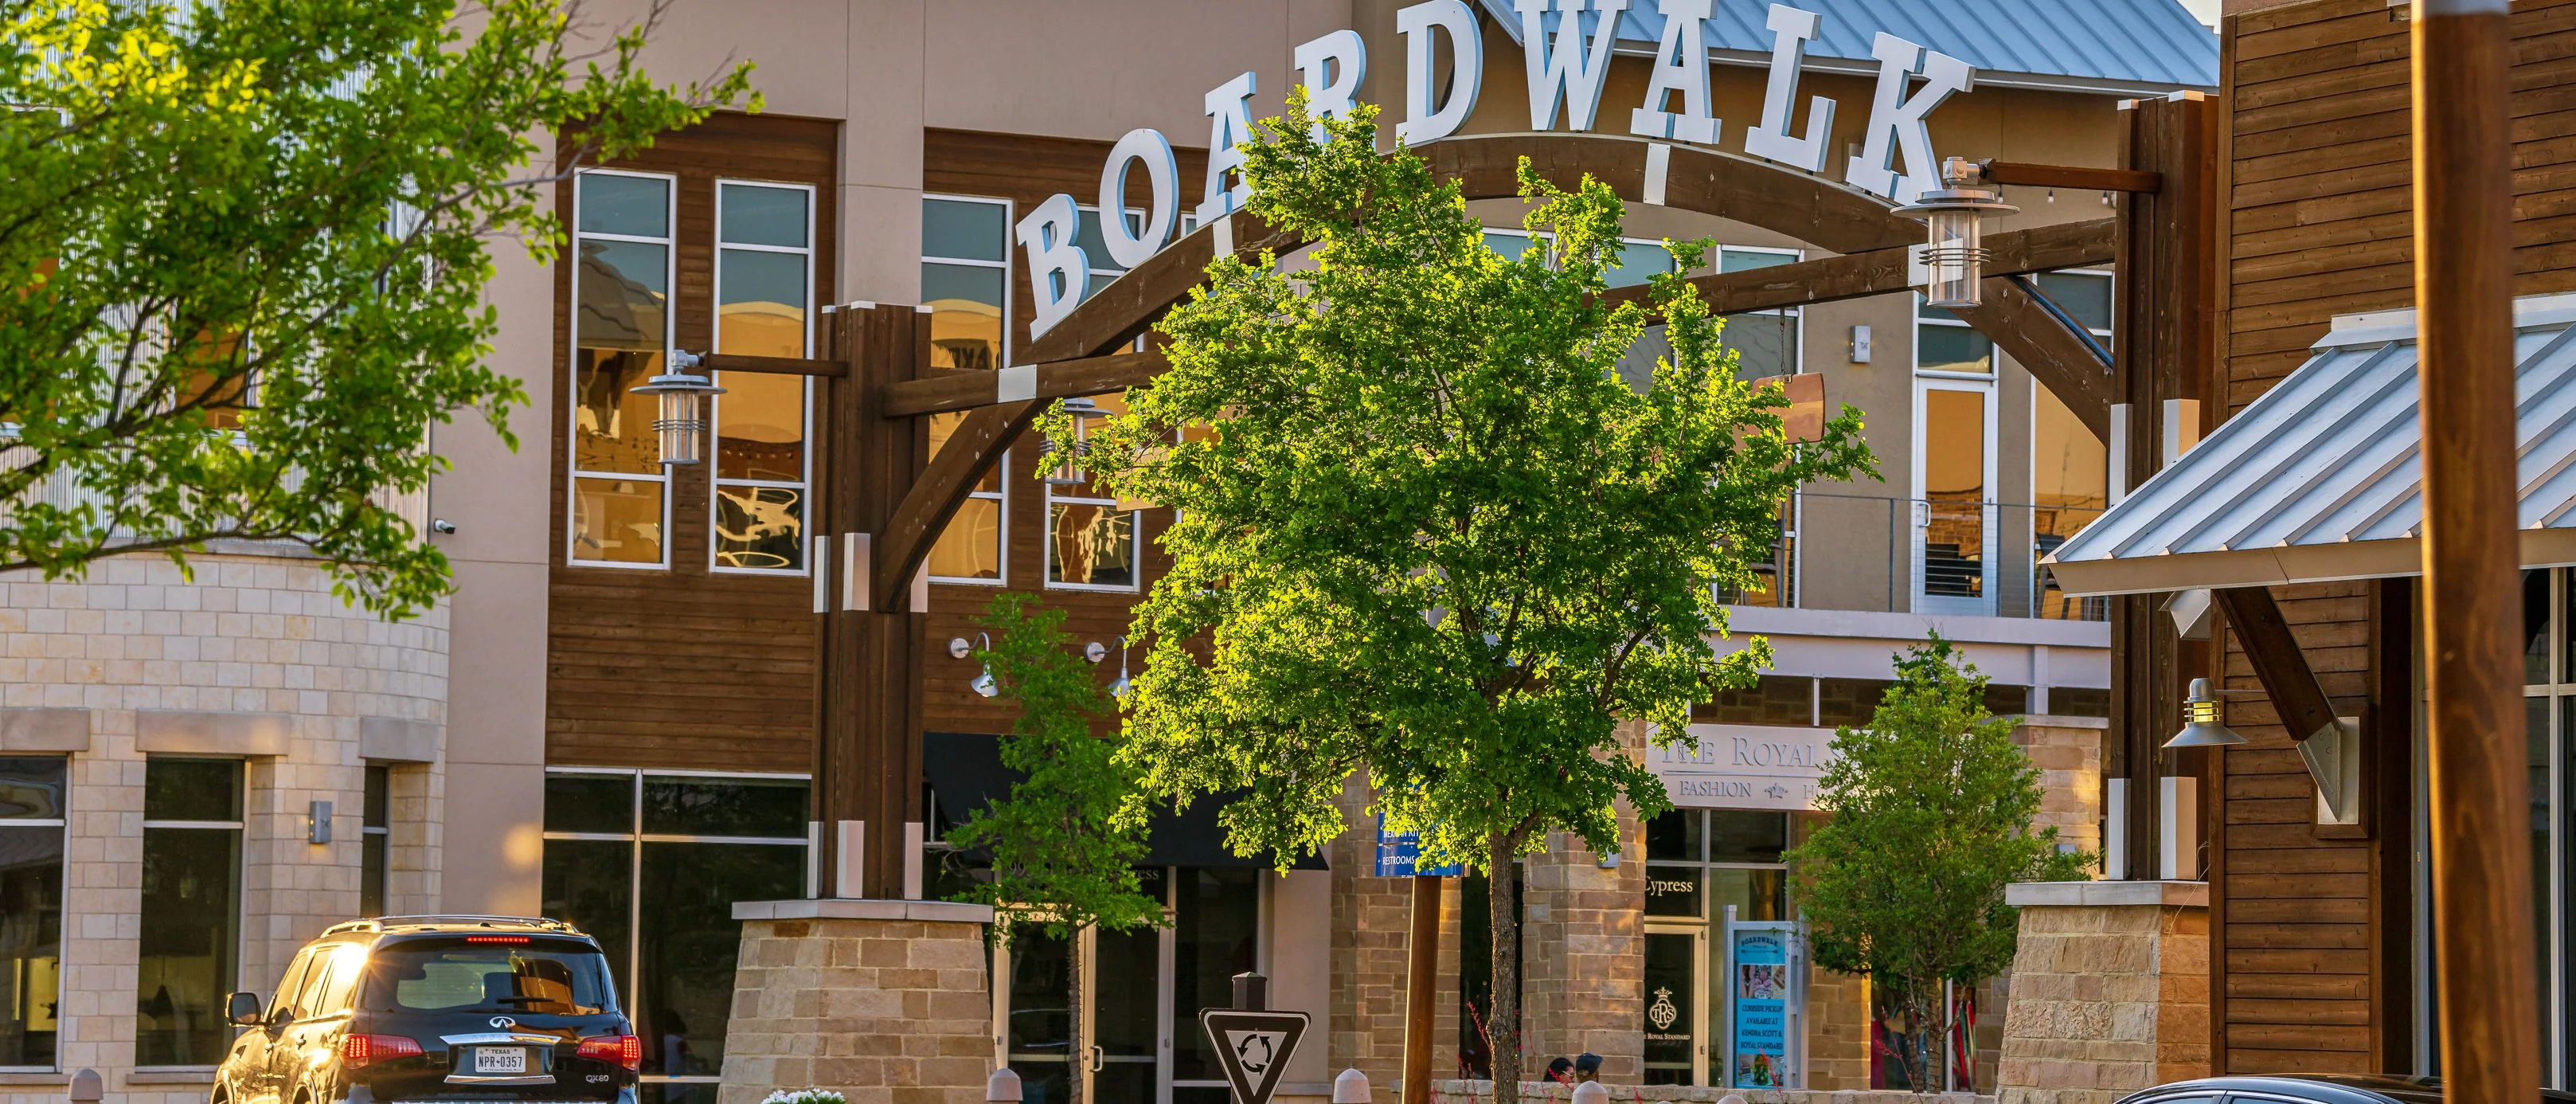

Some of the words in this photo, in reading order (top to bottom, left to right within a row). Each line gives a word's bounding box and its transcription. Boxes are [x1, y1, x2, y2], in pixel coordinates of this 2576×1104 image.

[1015, 0, 1976, 343] BOARDWALK
[1679, 780, 1753, 797] FASHION
[1382, 855, 1415, 865] RESTROOMS
[585, 1075, 609, 1083] QX80
